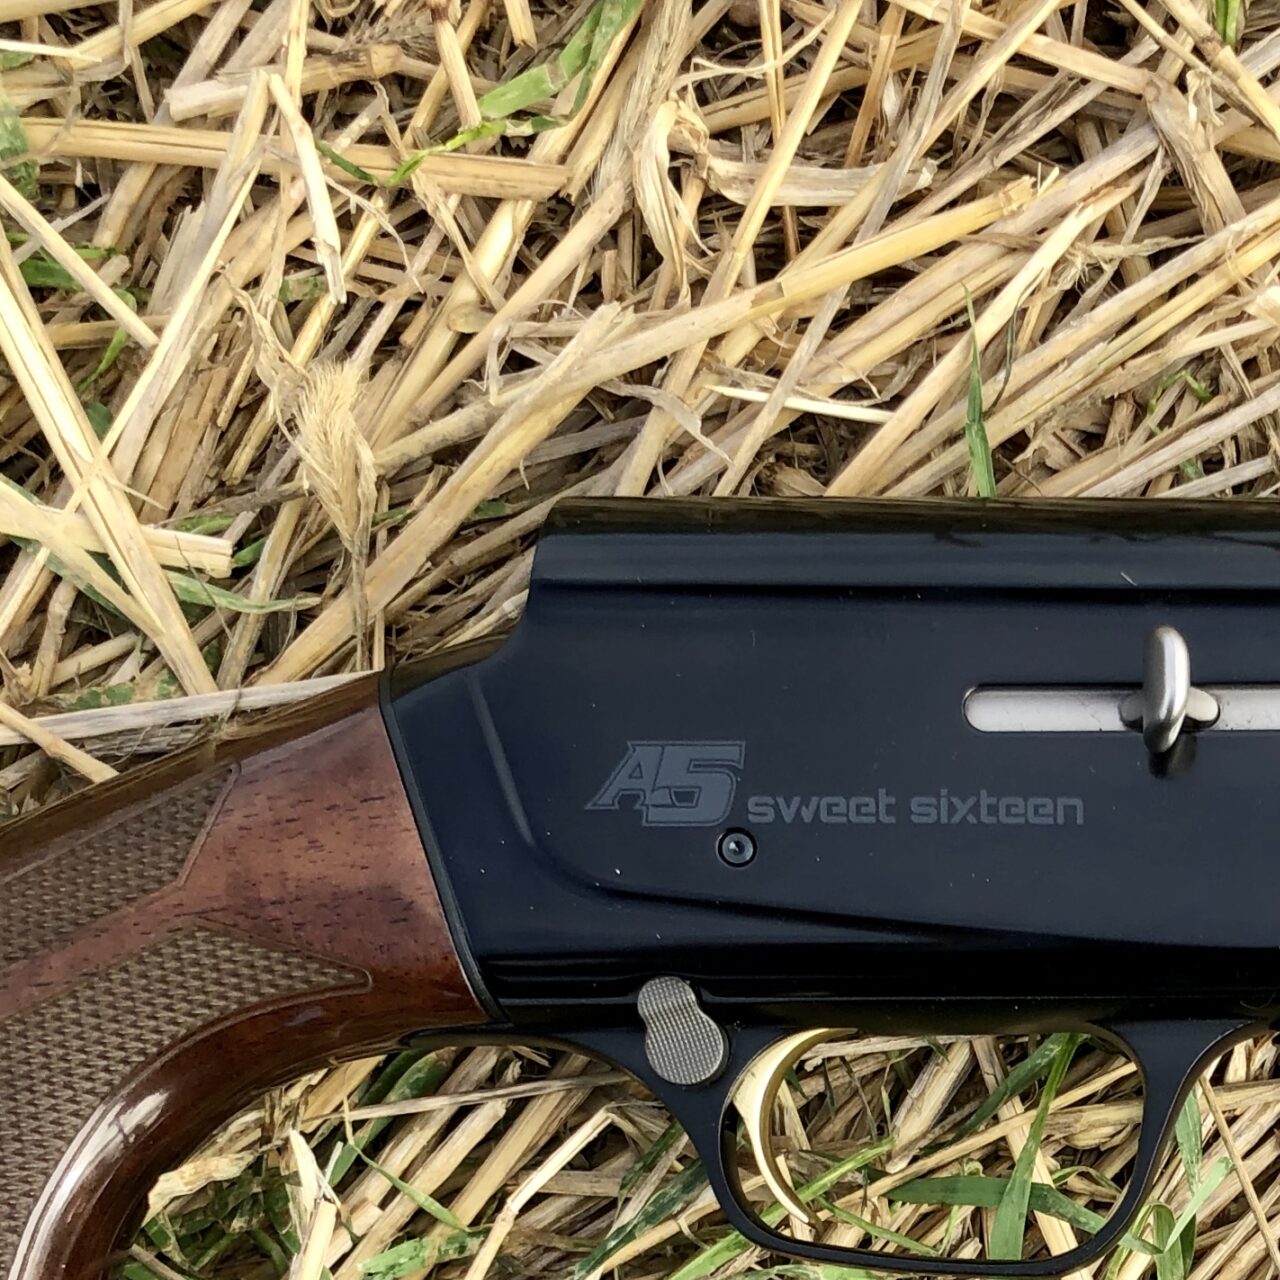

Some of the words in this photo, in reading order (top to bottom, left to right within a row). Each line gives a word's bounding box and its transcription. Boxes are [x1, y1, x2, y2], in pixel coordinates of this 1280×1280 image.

[584, 740, 746, 827] A5
[747, 788, 897, 824] sweet
[909, 788, 1085, 825] sixteen
